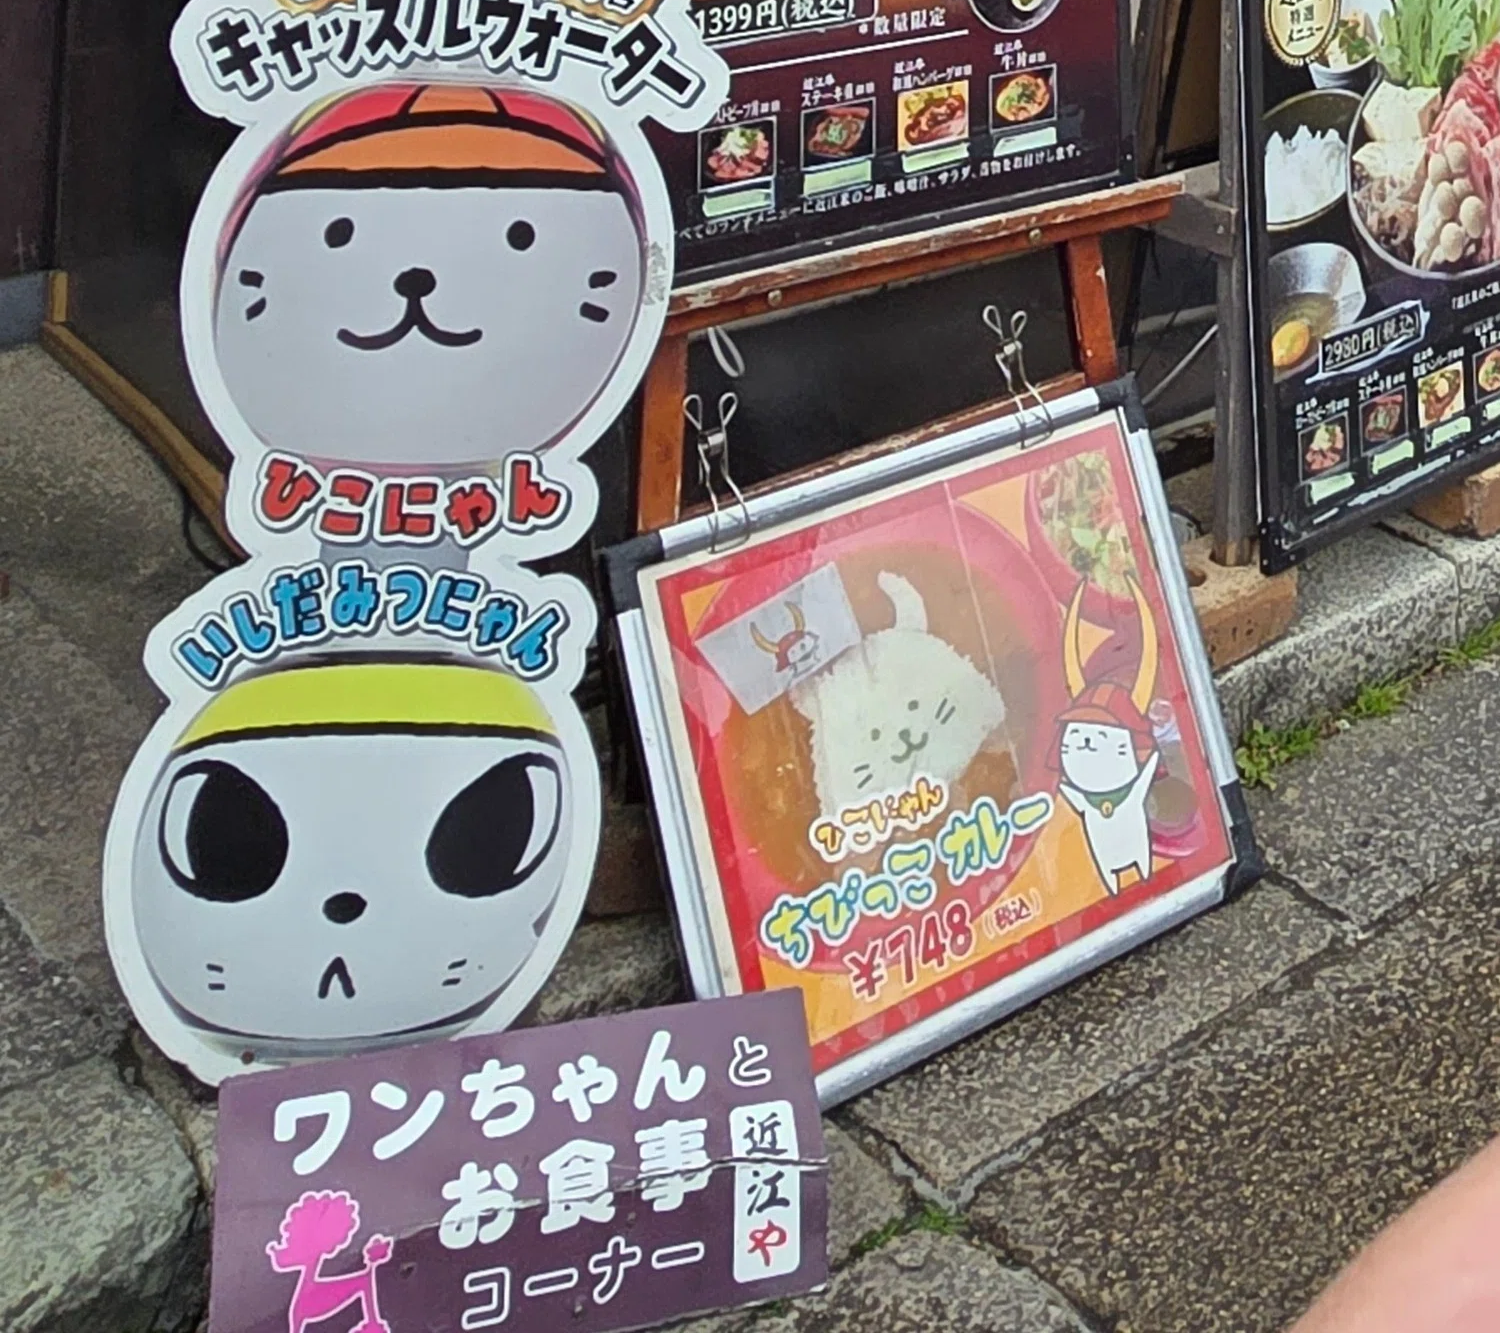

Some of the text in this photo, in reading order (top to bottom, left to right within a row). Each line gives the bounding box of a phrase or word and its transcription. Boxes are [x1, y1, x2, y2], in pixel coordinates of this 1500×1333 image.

[255, 449, 565, 538] ひこにゃん
[176, 563, 566, 685] いしだみつにゃん
[812, 779, 946, 854] ひこにゃん
[845, 904, 977, 1000] ¥748
[438, 1118, 712, 1250] お食事
[741, 1115, 792, 1266] 近江や
[461, 1236, 706, 1330] コーナー
